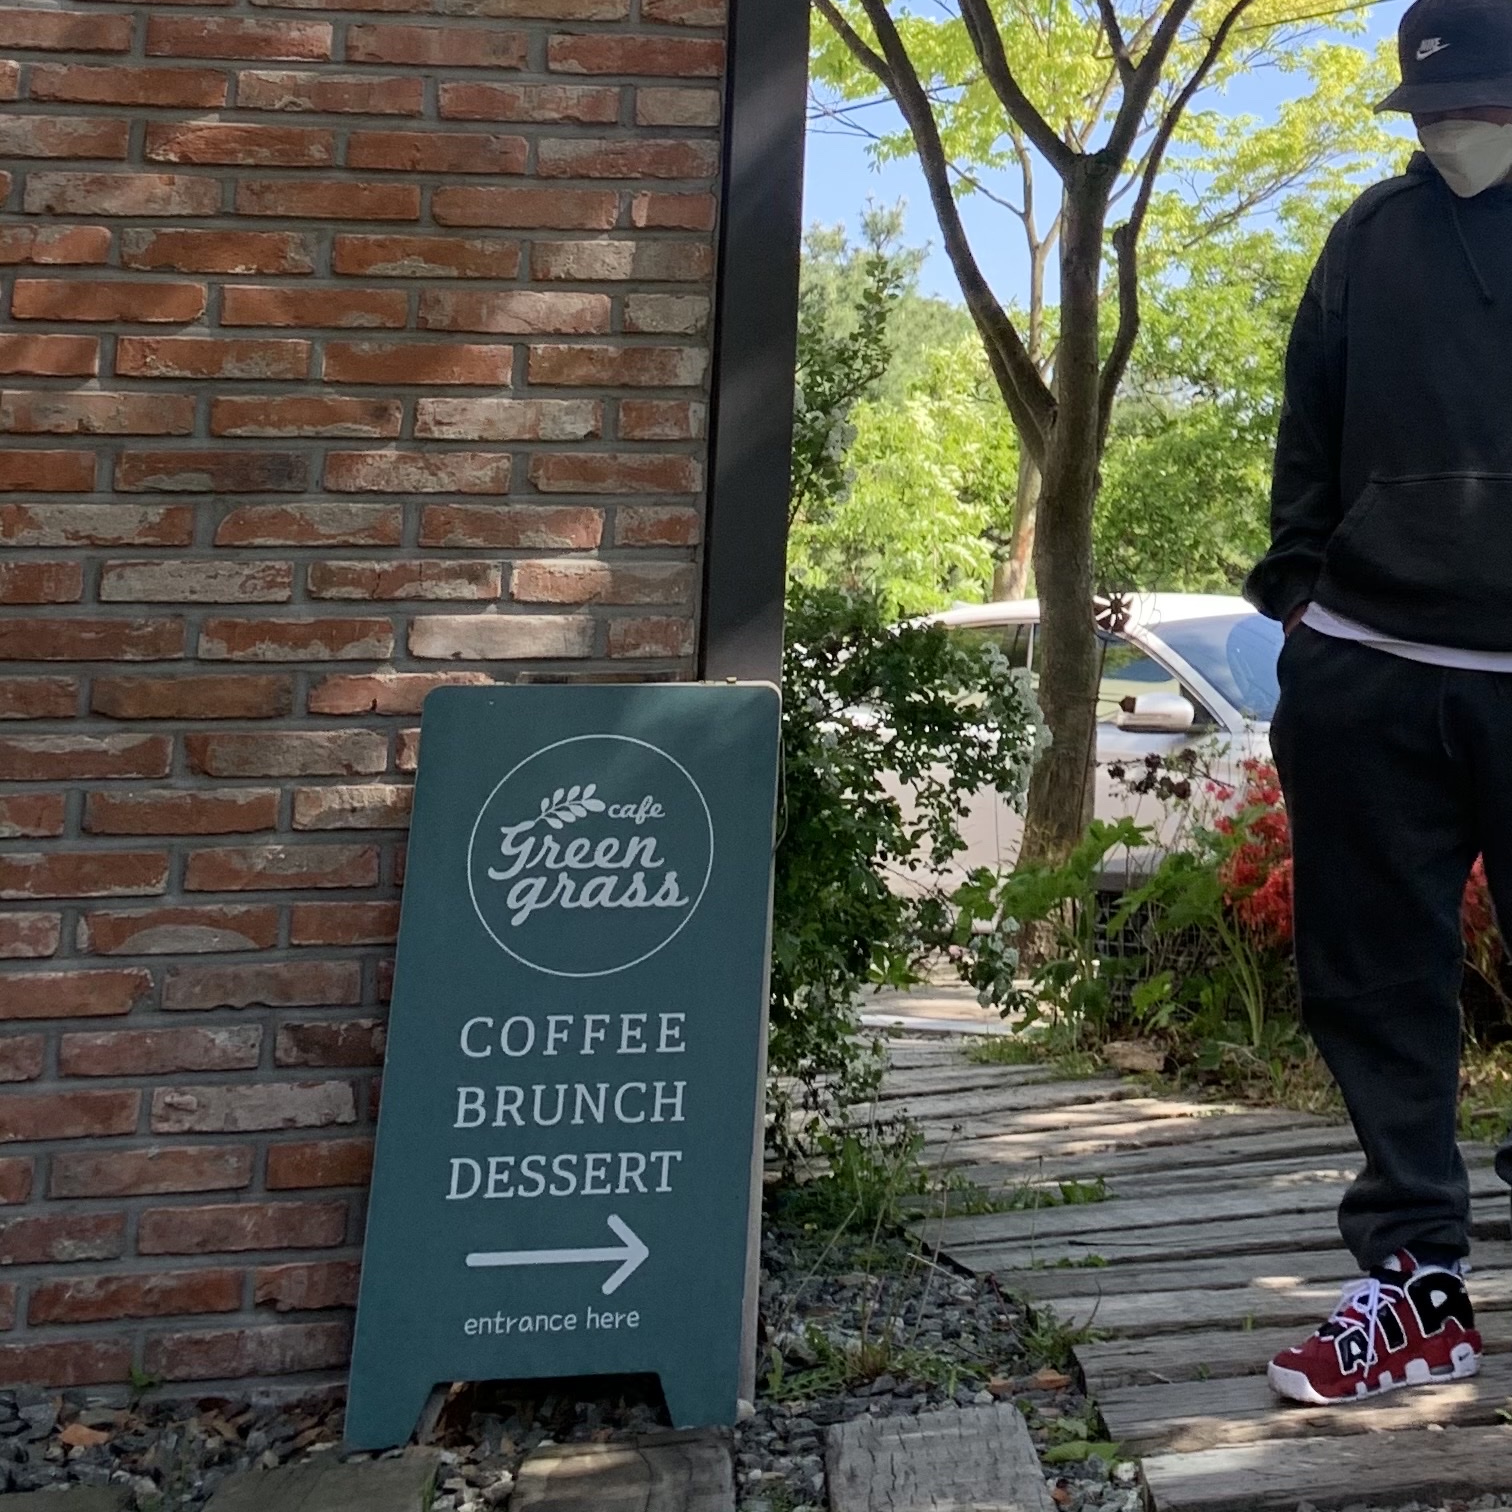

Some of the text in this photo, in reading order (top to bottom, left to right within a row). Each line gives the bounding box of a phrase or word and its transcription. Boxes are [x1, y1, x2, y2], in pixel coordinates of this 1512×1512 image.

[607, 795, 666, 825] cafe
[488, 820, 665, 881] Green
[506, 871, 690, 927] grass
[460, 1012, 686, 1058] COFFEE
[453, 1081, 687, 1128] BRUNCH
[445, 1151, 682, 1200] DESSERT
[464, 1306, 640, 1335] entrance here
